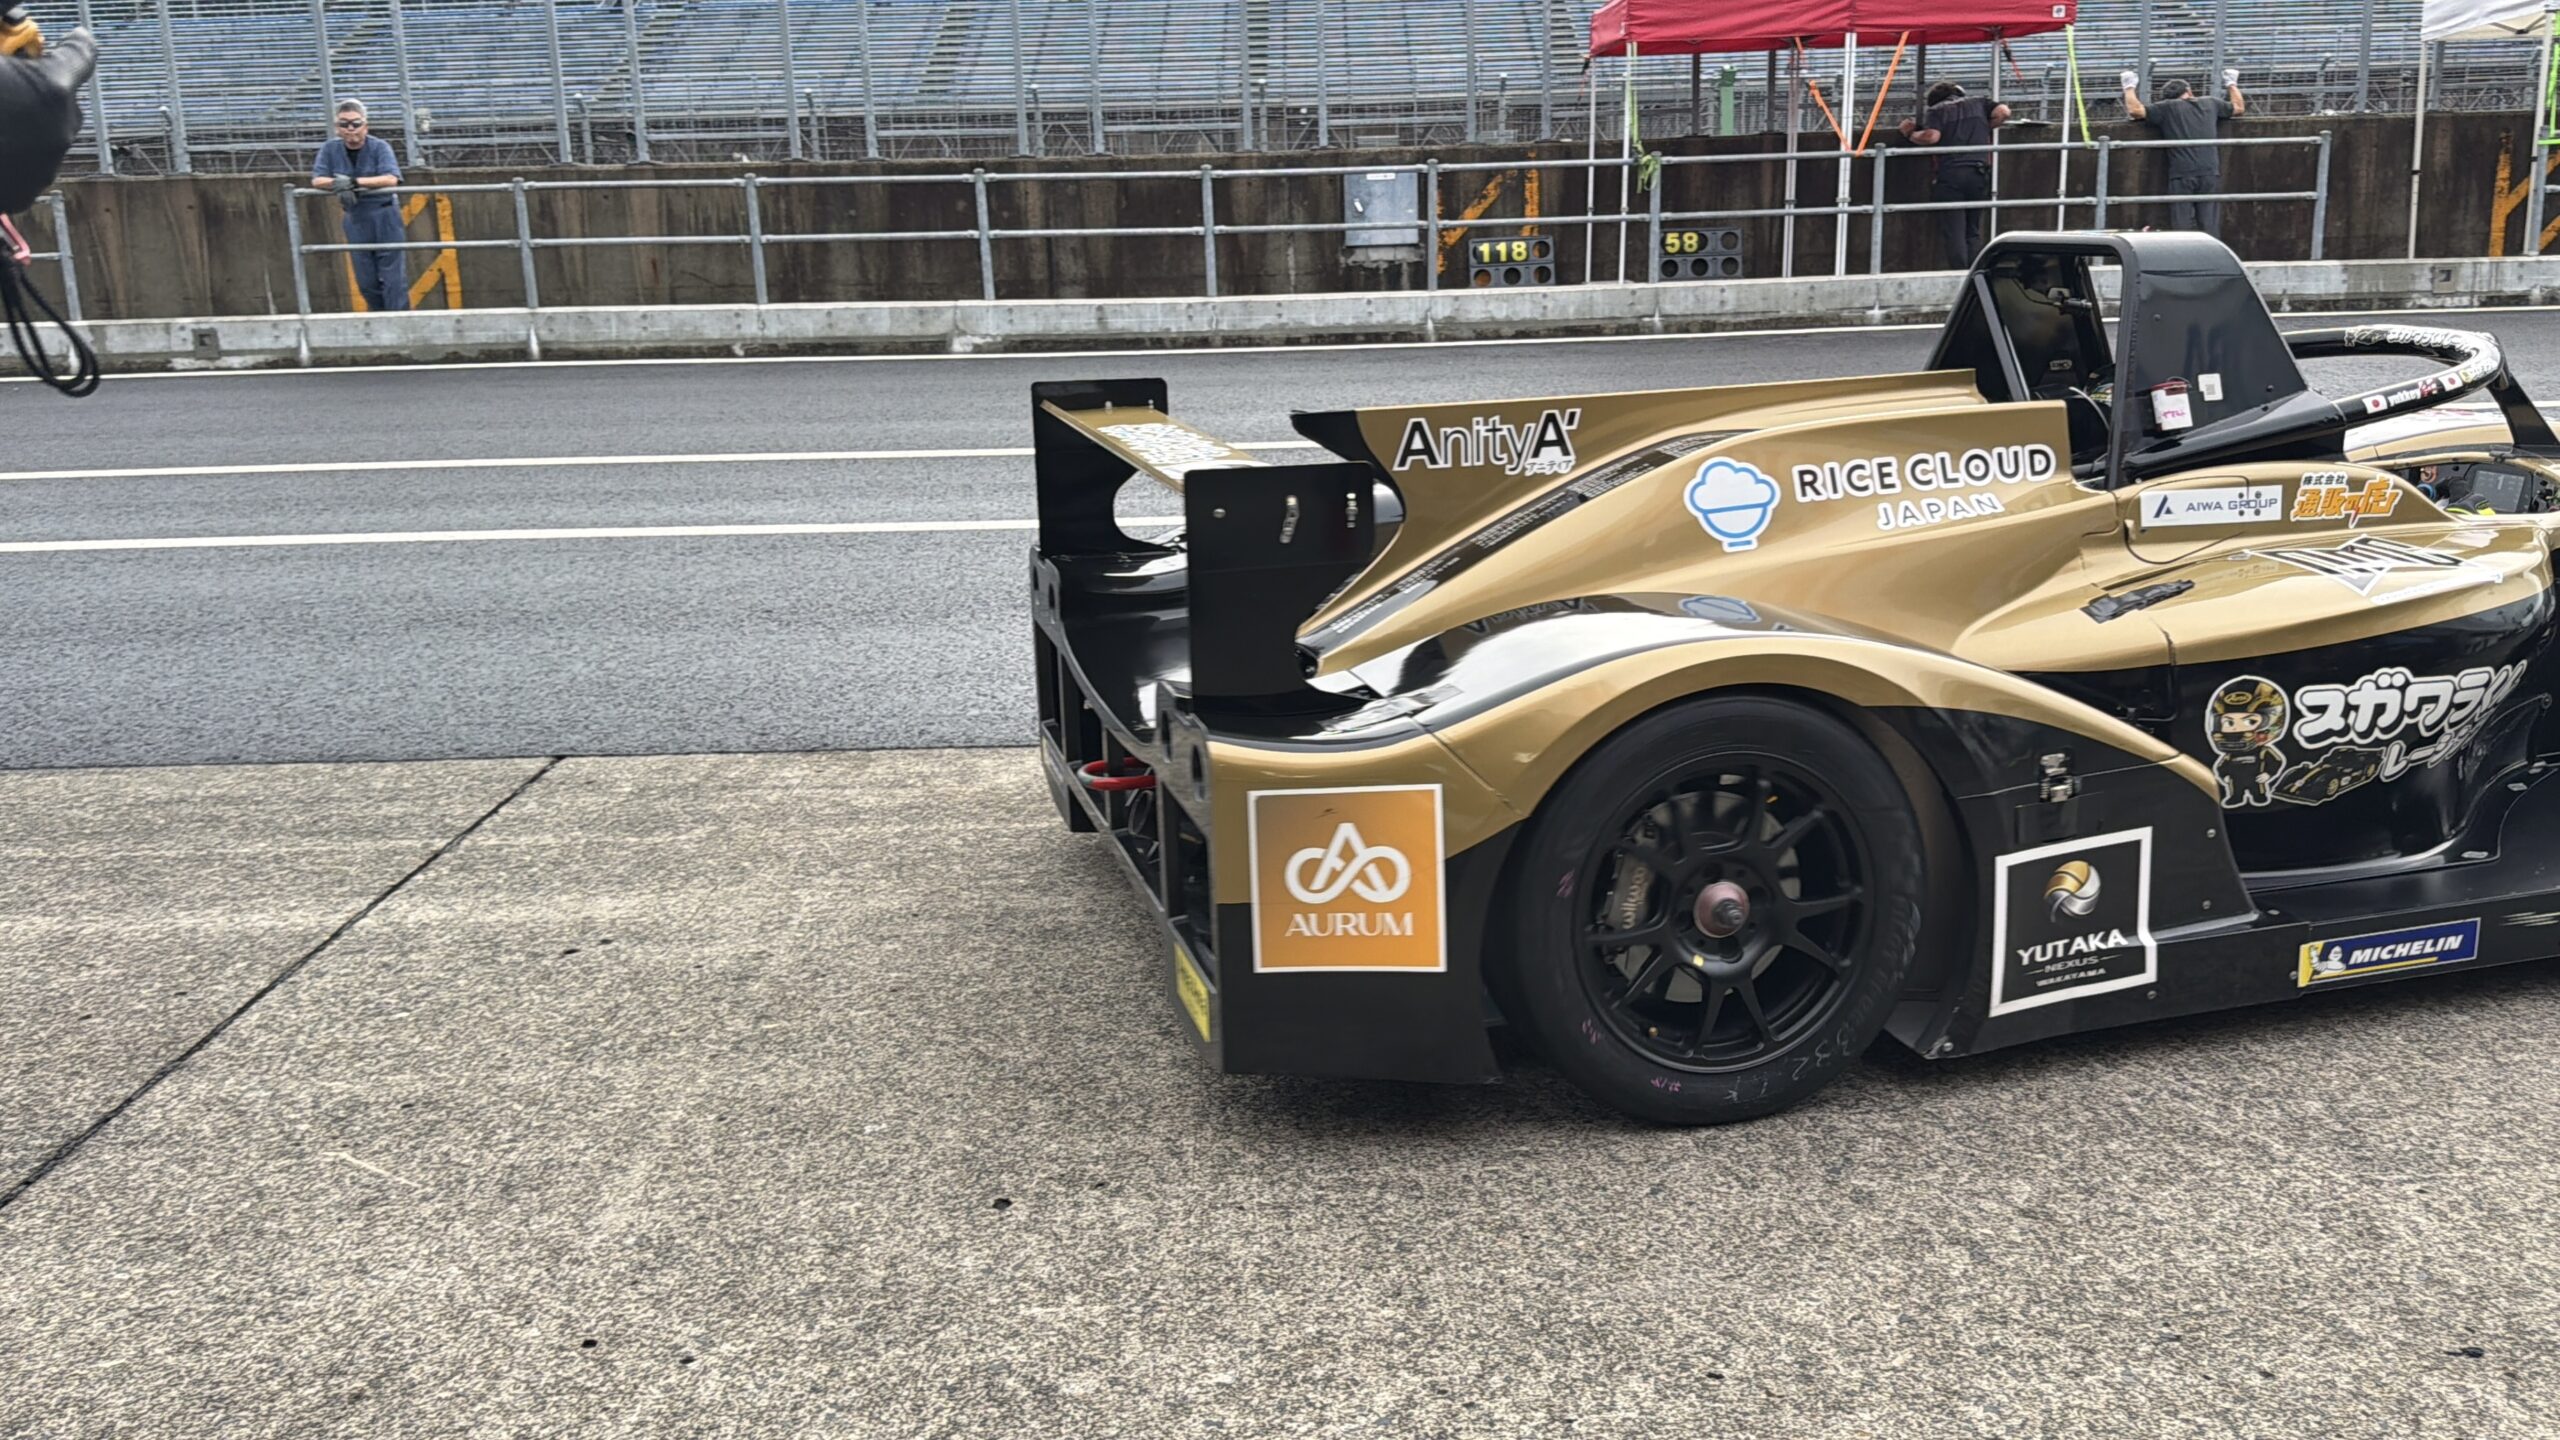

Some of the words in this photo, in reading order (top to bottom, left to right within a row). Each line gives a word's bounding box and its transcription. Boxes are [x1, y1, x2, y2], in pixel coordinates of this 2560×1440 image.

[1478, 240, 1528, 263] 118
[1665, 232, 1699, 253] 58
[1796, 459, 1899, 500] RICE
[1907, 446, 2053, 486] CLOUD
[2301, 474, 2348, 486] 株式会社
[1880, 494, 1999, 528] JAPAN
[2185, 500, 2223, 513] AIWA
[2227, 497, 2279, 511] GROUP
[1284, 911, 1415, 937] AURUM
[2016, 928, 2129, 966] YUTAKA
[2348, 934, 2465, 965] MICHELIN
[2044, 955, 2099, 973] NEXUS
